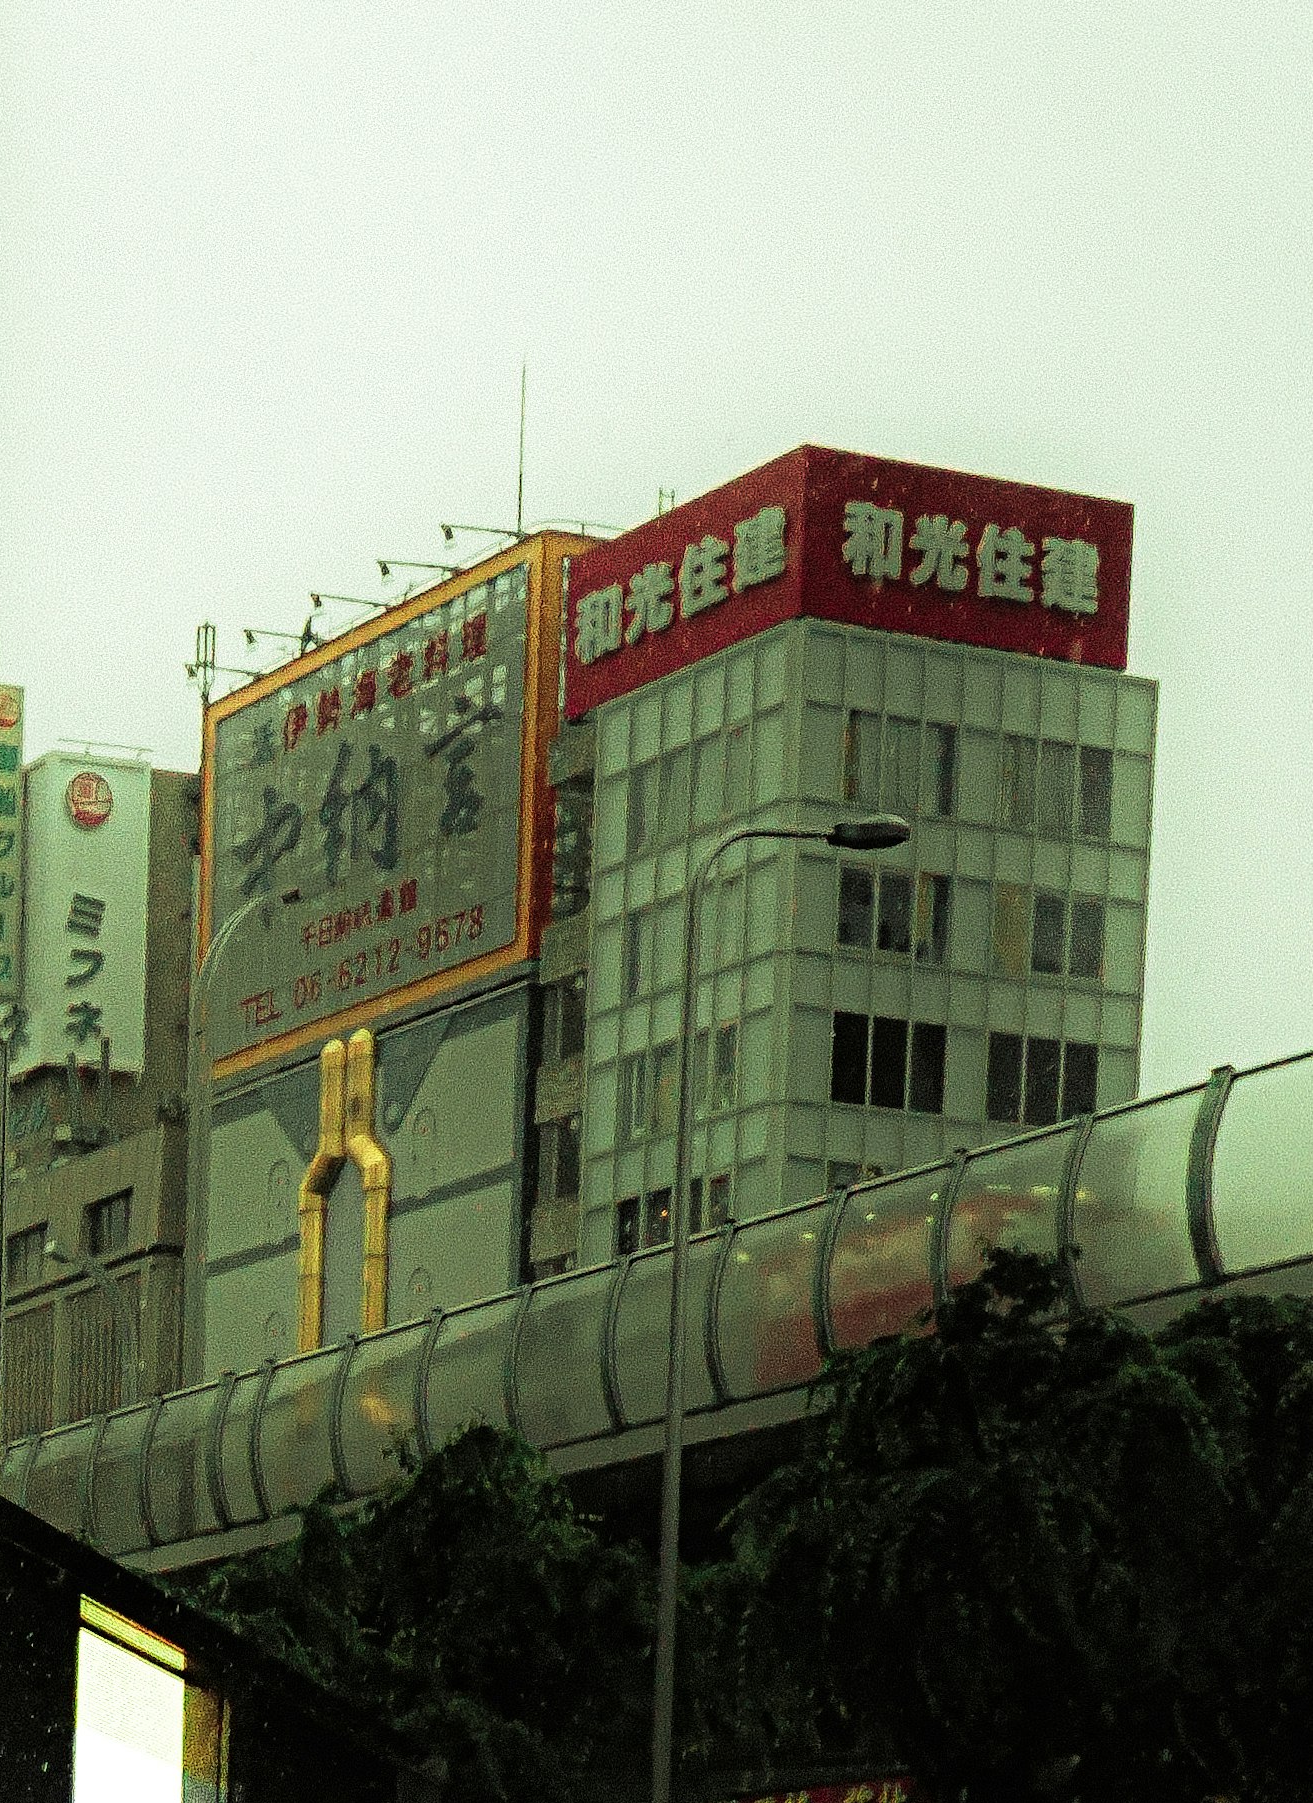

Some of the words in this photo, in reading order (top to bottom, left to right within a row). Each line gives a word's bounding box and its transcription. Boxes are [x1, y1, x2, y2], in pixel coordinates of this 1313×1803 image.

[574, 505, 787, 666] 和光住建
[843, 500, 1101, 616] 和光住建
[66, 892, 107, 1042] ミフネ
[239, 989, 284, 1028] TEL
